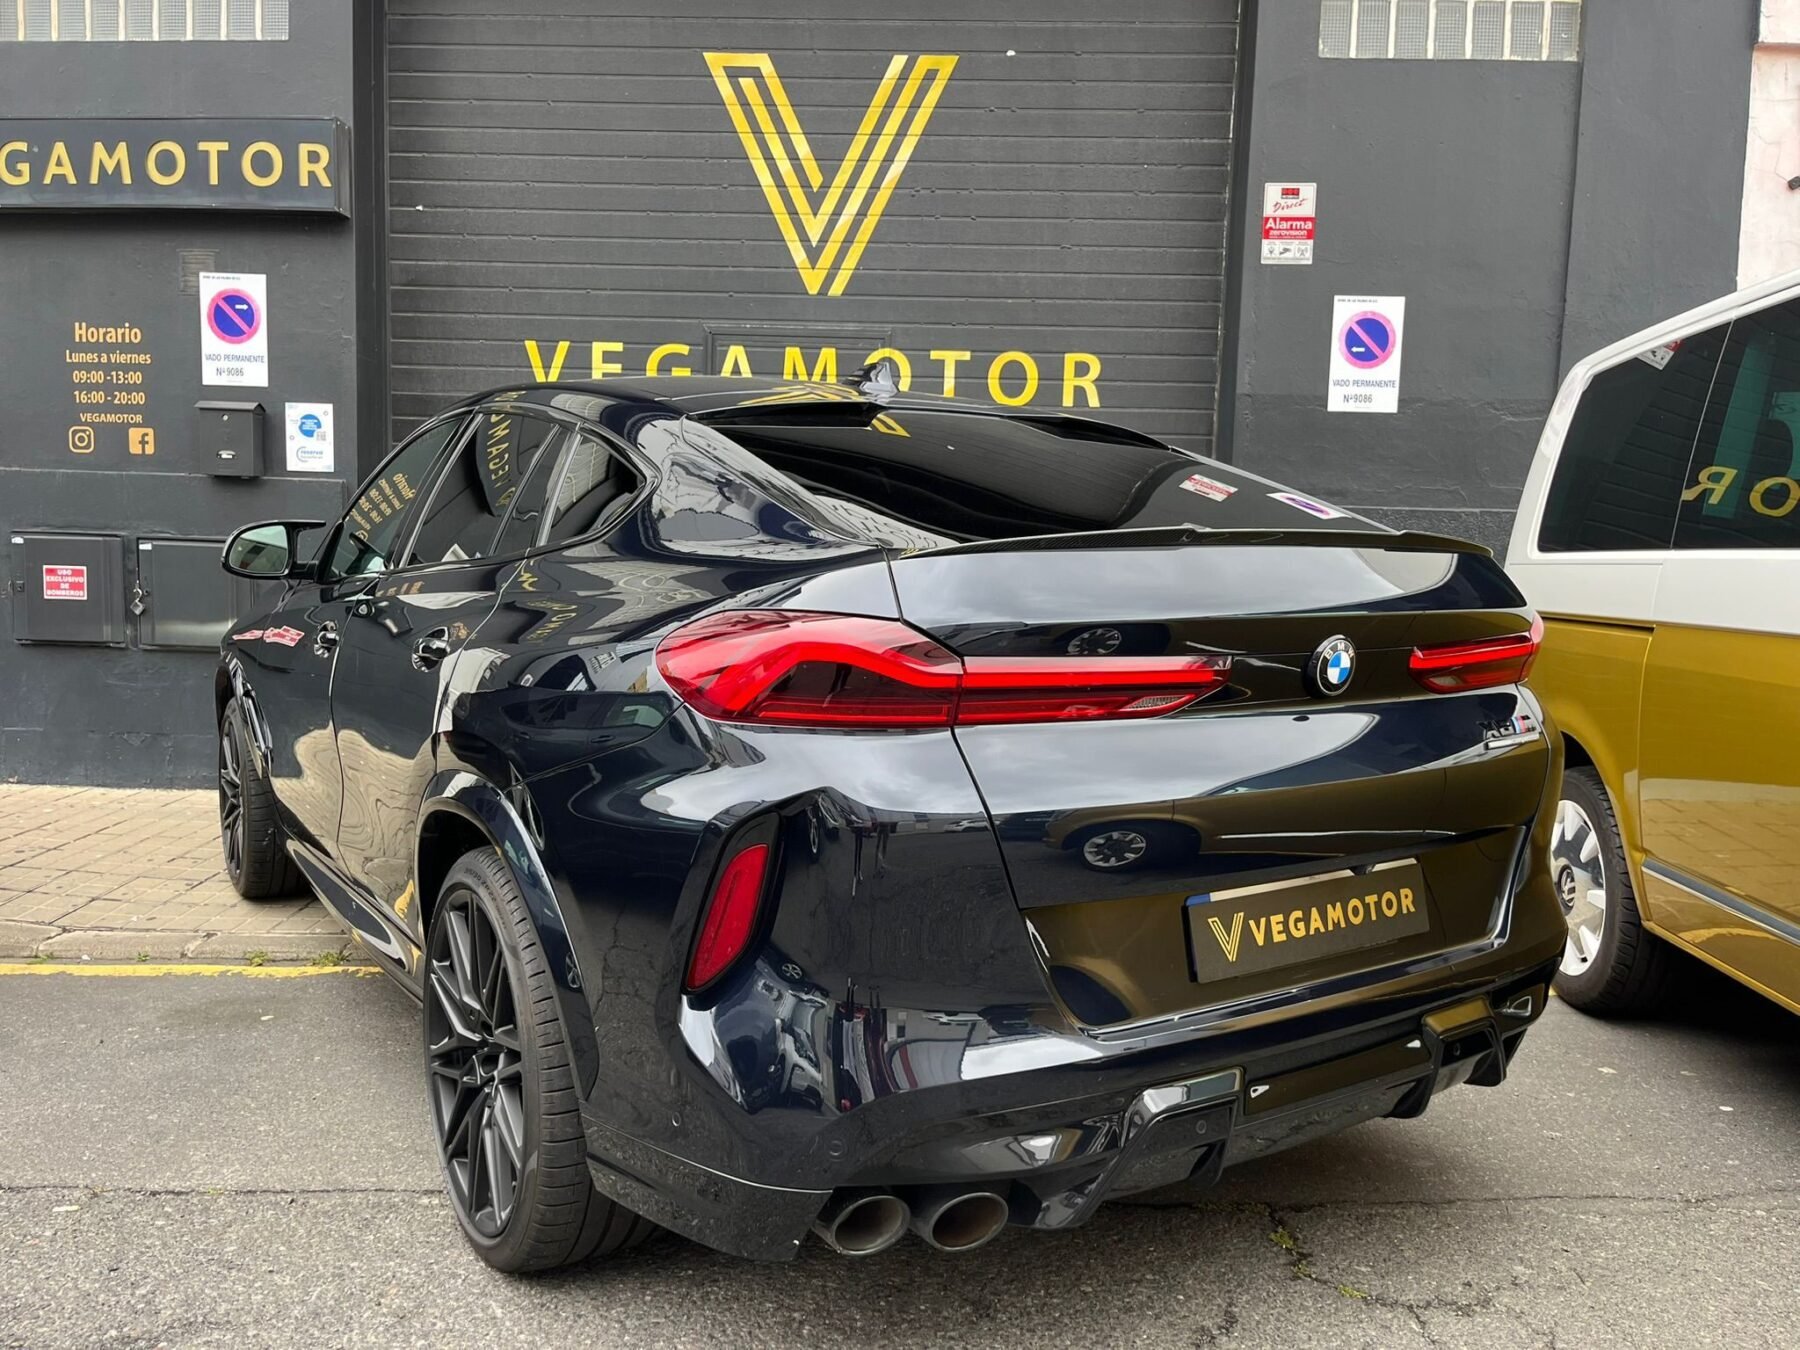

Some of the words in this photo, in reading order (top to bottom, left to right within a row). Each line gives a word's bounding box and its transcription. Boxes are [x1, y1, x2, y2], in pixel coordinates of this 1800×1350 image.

[0, 140, 333, 188] GAMOTOR
[1265, 217, 1312, 230] Alarma
[74, 321, 142, 344] Horario
[65, 349, 99, 363] Lunes
[100, 353, 108, 363] a
[110, 350, 152, 364] viernes
[205, 353, 222, 362] VADO
[223, 354, 265, 363] PERMANENTE
[72, 370, 104, 384] 09:00
[1332, 379, 1350, 387] VADO
[1352, 380, 1397, 388] PERMANENTE
[73, 390, 105, 404] 16:00
[113, 391, 146, 405] 20:00
[79, 412, 143, 424] VEGAMOTOR
[46, 589, 84, 597] BOMBEROS
[1249, 888, 1416, 947] VEGAMOTOR
